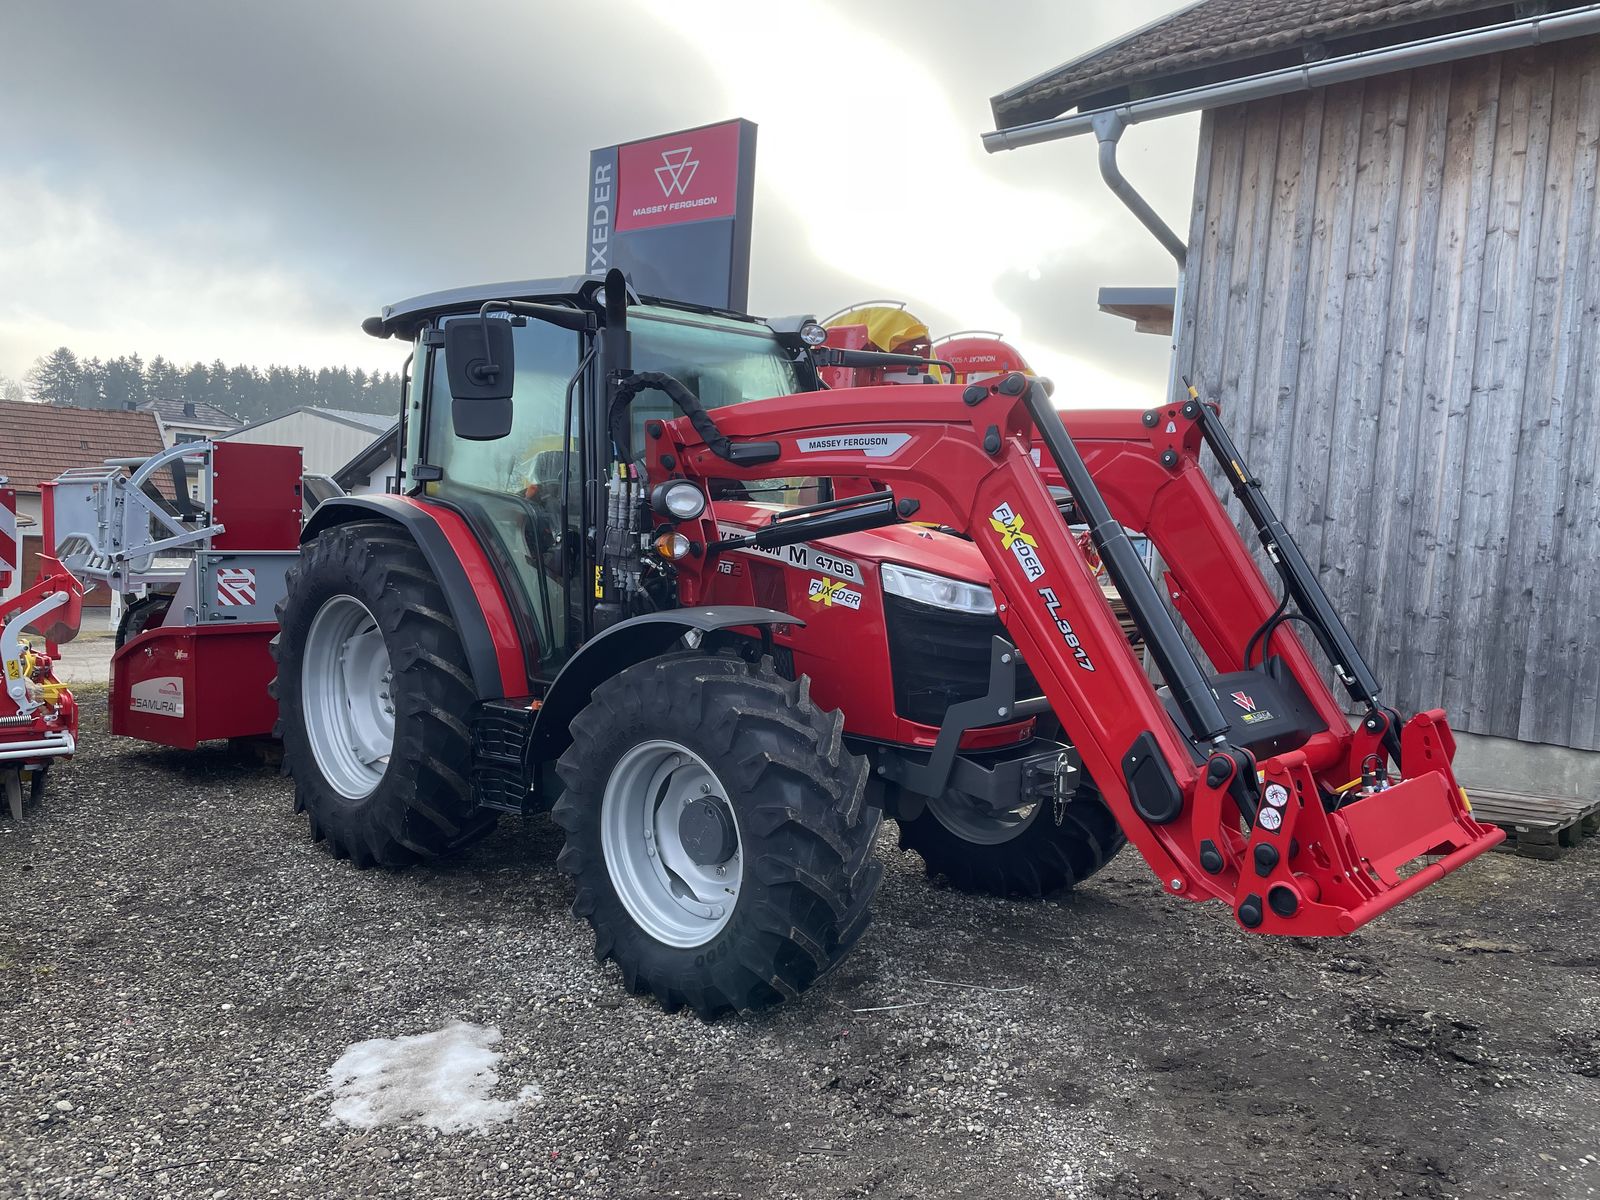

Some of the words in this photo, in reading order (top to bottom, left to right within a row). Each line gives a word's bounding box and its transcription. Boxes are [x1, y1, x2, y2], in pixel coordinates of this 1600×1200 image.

[632, 204, 668, 216] MASSEY
[669, 196, 718, 211] FERGUSON
[808, 440, 841, 449] MASSEY
[843, 437, 888, 447] FERGUSON
[789, 545, 807, 565] M
[815, 556, 854, 577] 4708
[1037, 586, 1096, 672] FL.3817
[135, 698, 177, 713] SAMURAI
